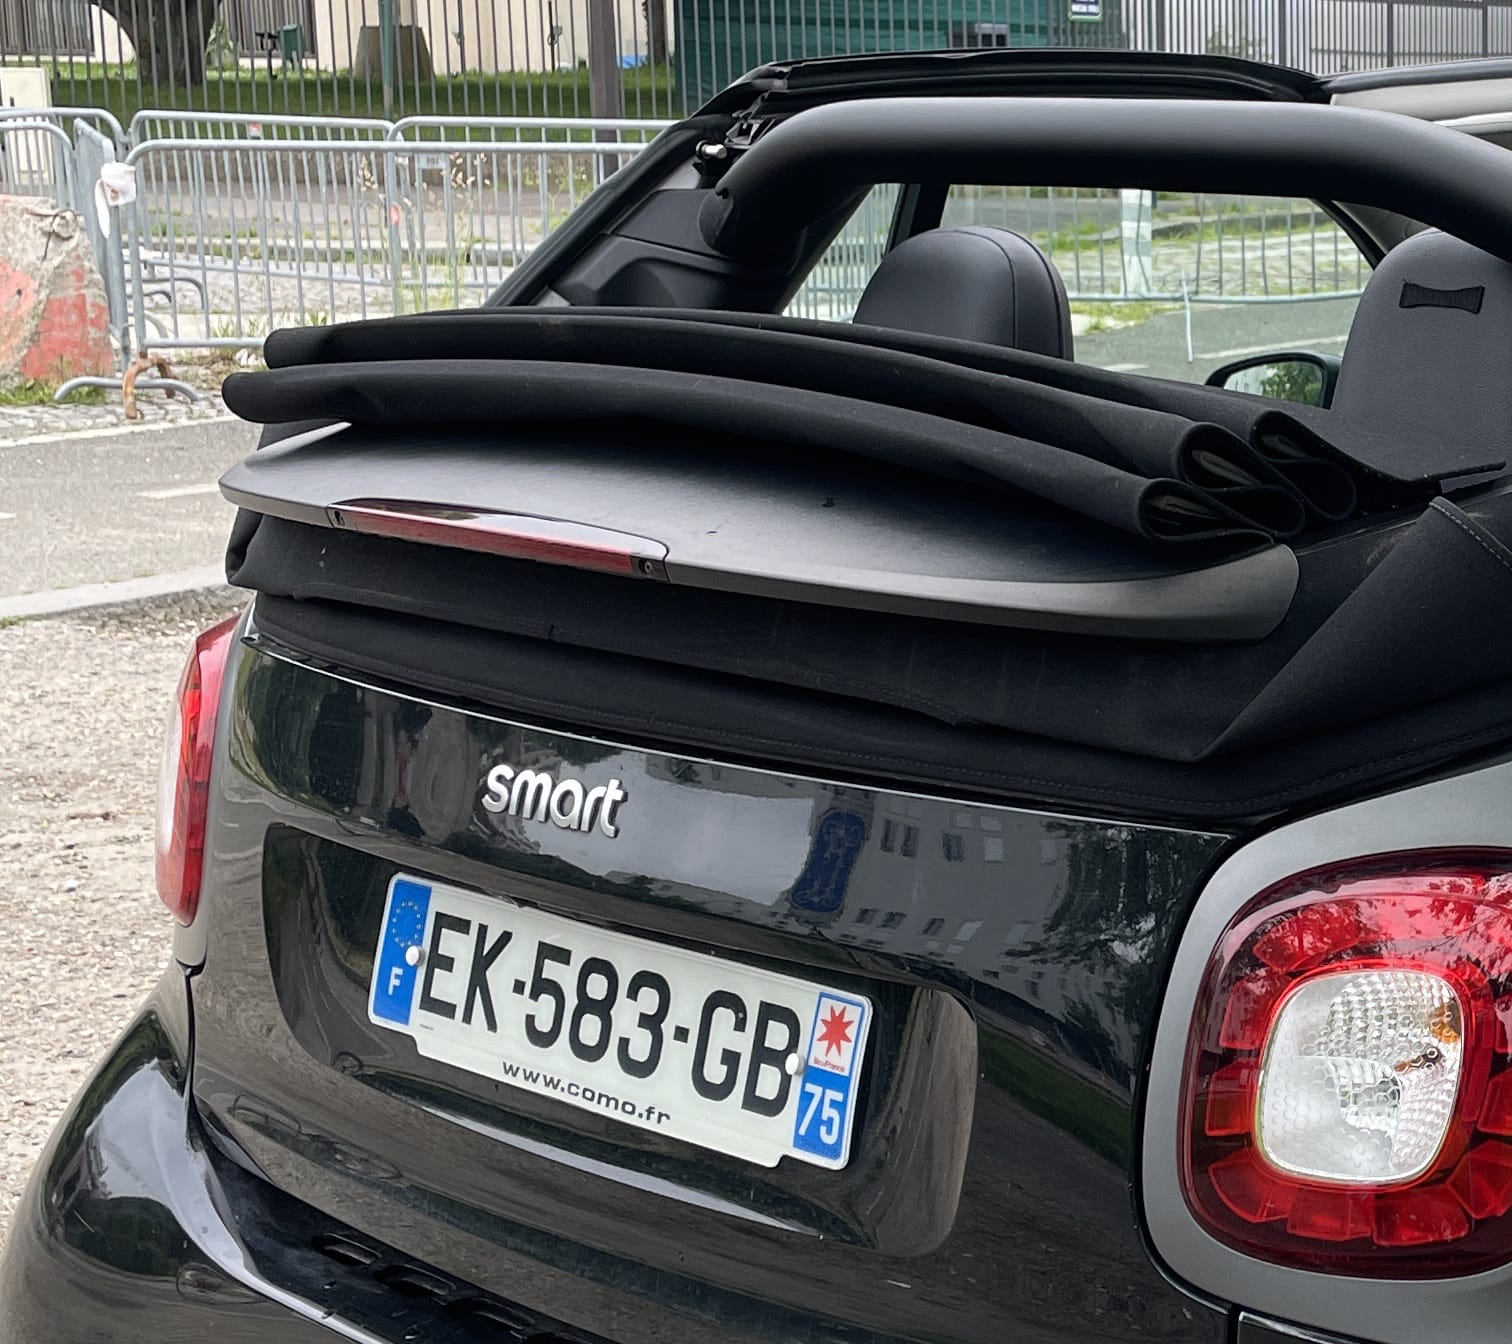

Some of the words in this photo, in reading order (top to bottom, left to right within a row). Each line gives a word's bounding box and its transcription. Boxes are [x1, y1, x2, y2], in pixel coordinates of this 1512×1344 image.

[481, 764, 626, 839] smart
[388, 966, 404, 996] F
[418, 911, 801, 1118] EK-583-GB
[502, 1061, 671, 1125] www.como.fr
[799, 1082, 844, 1146] 75
